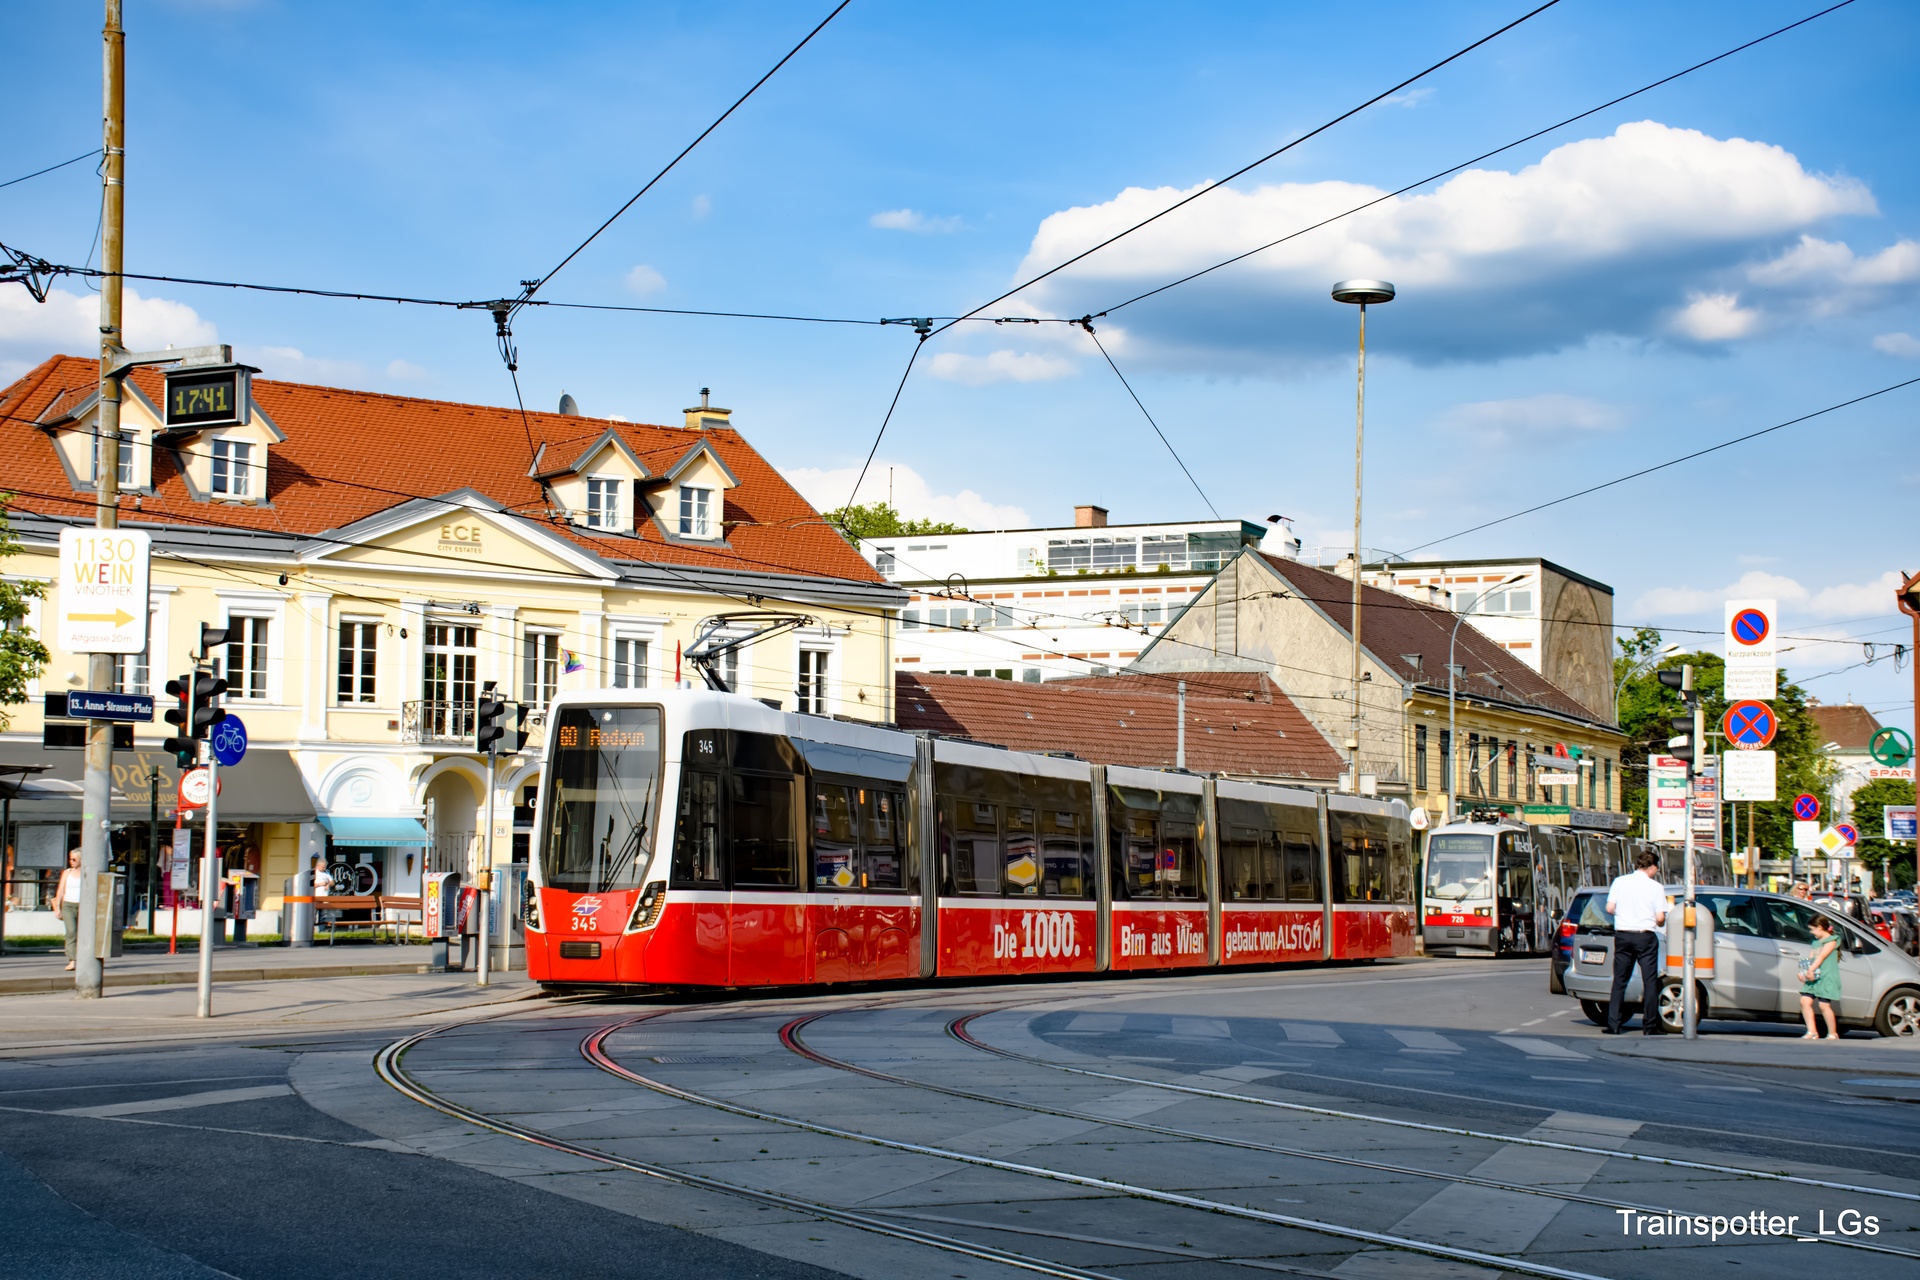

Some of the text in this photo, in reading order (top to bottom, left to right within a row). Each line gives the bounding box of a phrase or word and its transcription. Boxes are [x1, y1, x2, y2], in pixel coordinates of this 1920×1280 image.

[176, 387, 227, 415] 17:41
[441, 524, 481, 541] ECE
[74, 537, 135, 562] 1130
[74, 563, 133, 584] WEIN
[75, 585, 133, 596] VINOTHEK
[71, 634, 110, 644] Altgasse
[84, 700, 152, 714] Anna-Strauss-Platz
[590, 729, 645, 746] Rodaun
[1735, 740, 1764, 750] ANFANG
[699, 739, 713, 754] 345
[1541, 775, 1575, 783] APOTHEKE
[1869, 769, 1911, 777] SPAR
[1438, 840, 1446, 850] 49
[571, 916, 597, 931] 345
[1451, 915, 1464, 924] 720
[994, 912, 1081, 958] Die 1000.
[1121, 923, 1204, 957] Bim aus Wien
[1225, 920, 1321, 958] gebaut von ALSTOM
